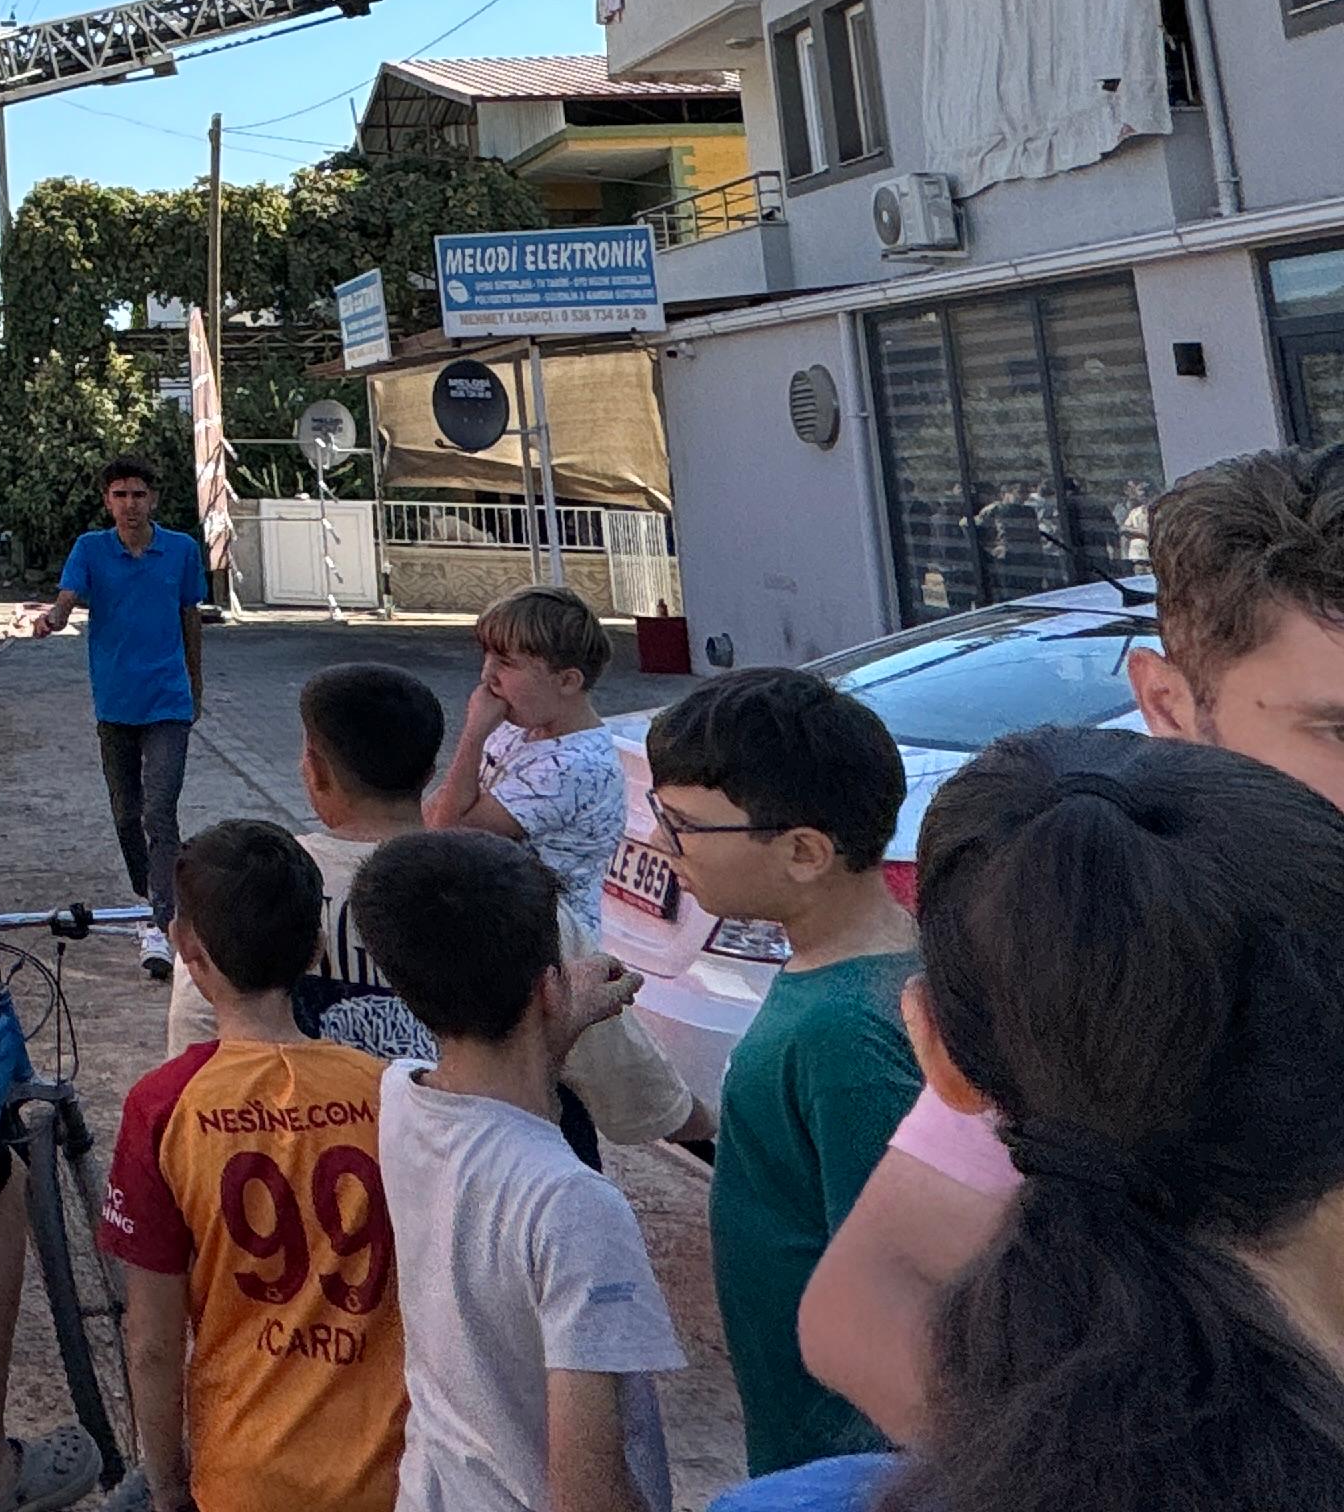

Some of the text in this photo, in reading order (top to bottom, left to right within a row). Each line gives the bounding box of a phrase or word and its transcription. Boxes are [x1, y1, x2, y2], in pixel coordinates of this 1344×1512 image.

[446, 234, 647, 275] MELODİ ELEKTRONİK
[220, 1144, 395, 1316] 99
[257, 1318, 367, 1366] ICARDI
